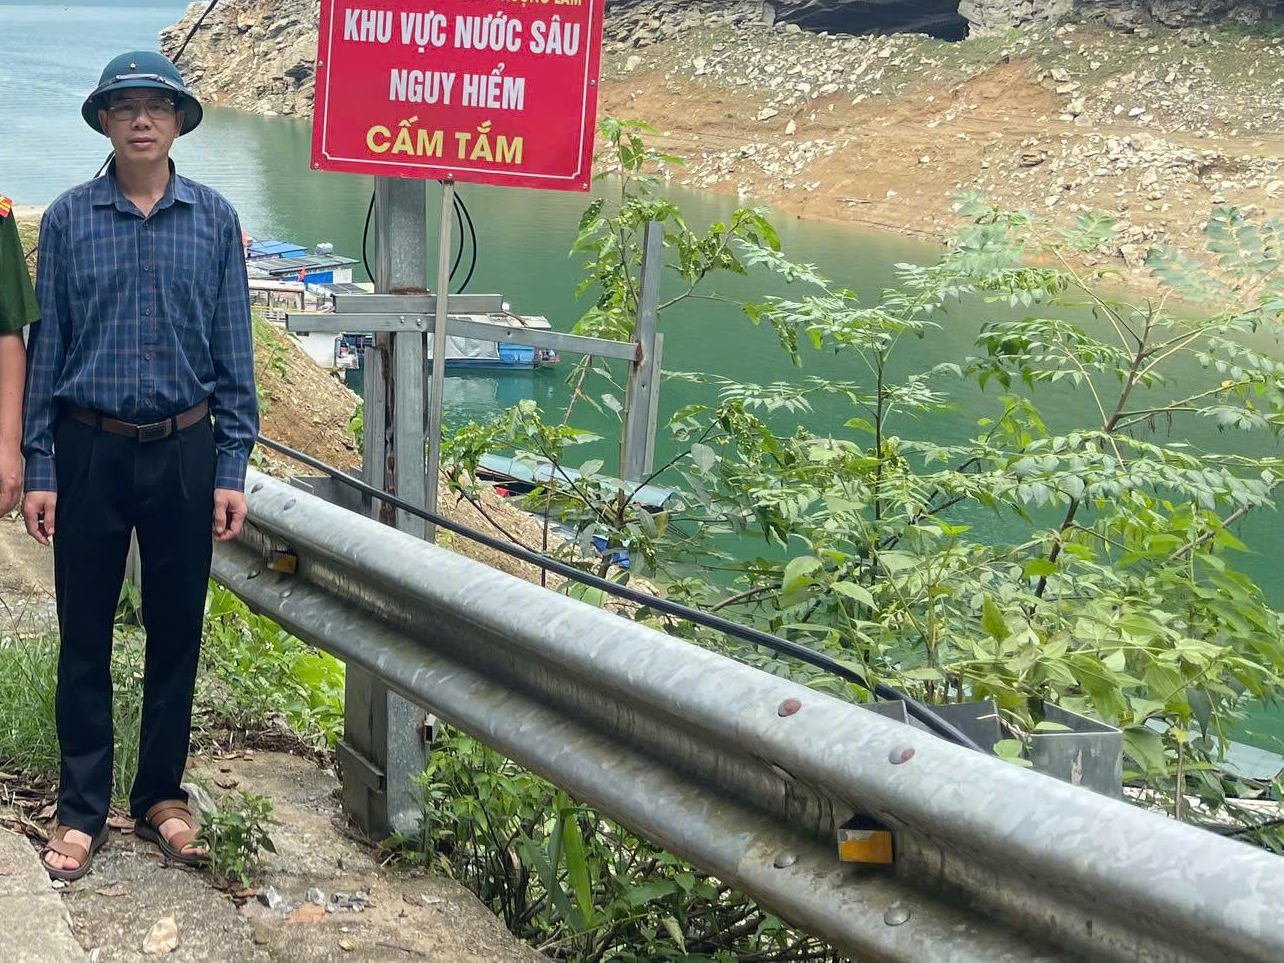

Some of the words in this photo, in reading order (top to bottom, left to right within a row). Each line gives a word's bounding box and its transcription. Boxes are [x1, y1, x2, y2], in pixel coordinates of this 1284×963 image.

[344, 8, 393, 44] KHU
[400, 10, 447, 53] VỰC
[454, 11, 522, 52] NƯỚC
[529, 15, 580, 56] SÂU
[389, 68, 456, 105] NGUY
[462, 63, 525, 111] HIỂM
[366, 115, 444, 158] CẤM
[455, 120, 524, 165] TẮM
